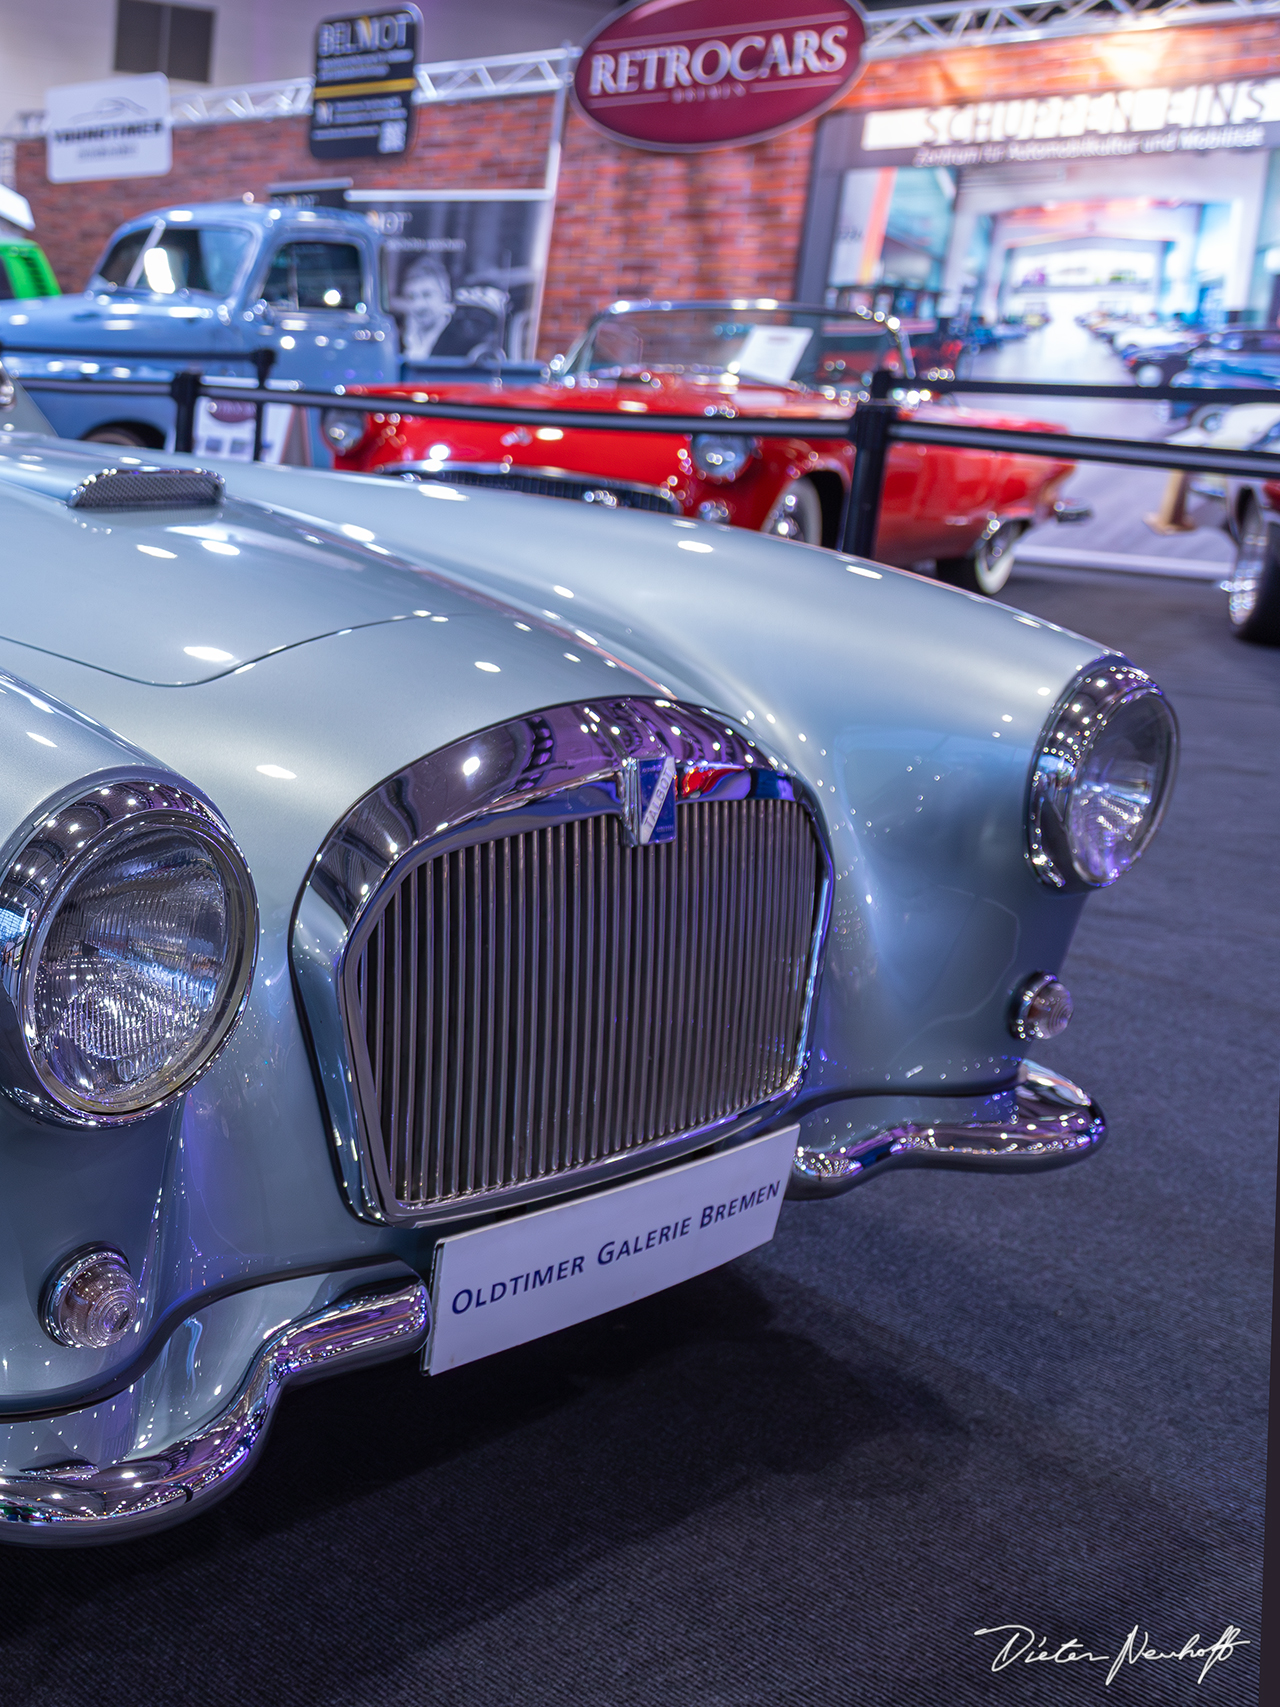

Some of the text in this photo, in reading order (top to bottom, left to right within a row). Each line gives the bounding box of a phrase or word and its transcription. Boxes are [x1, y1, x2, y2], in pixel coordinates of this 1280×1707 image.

[318, 13, 413, 56] BELMOT
[589, 25, 849, 96] RETROCARS
[920, 78, 1266, 147] SCHUPPEN EINS
[644, 766, 674, 828] TALBOT
[452, 1180, 781, 1314] OLDTIMER GALERIE BREMEN
